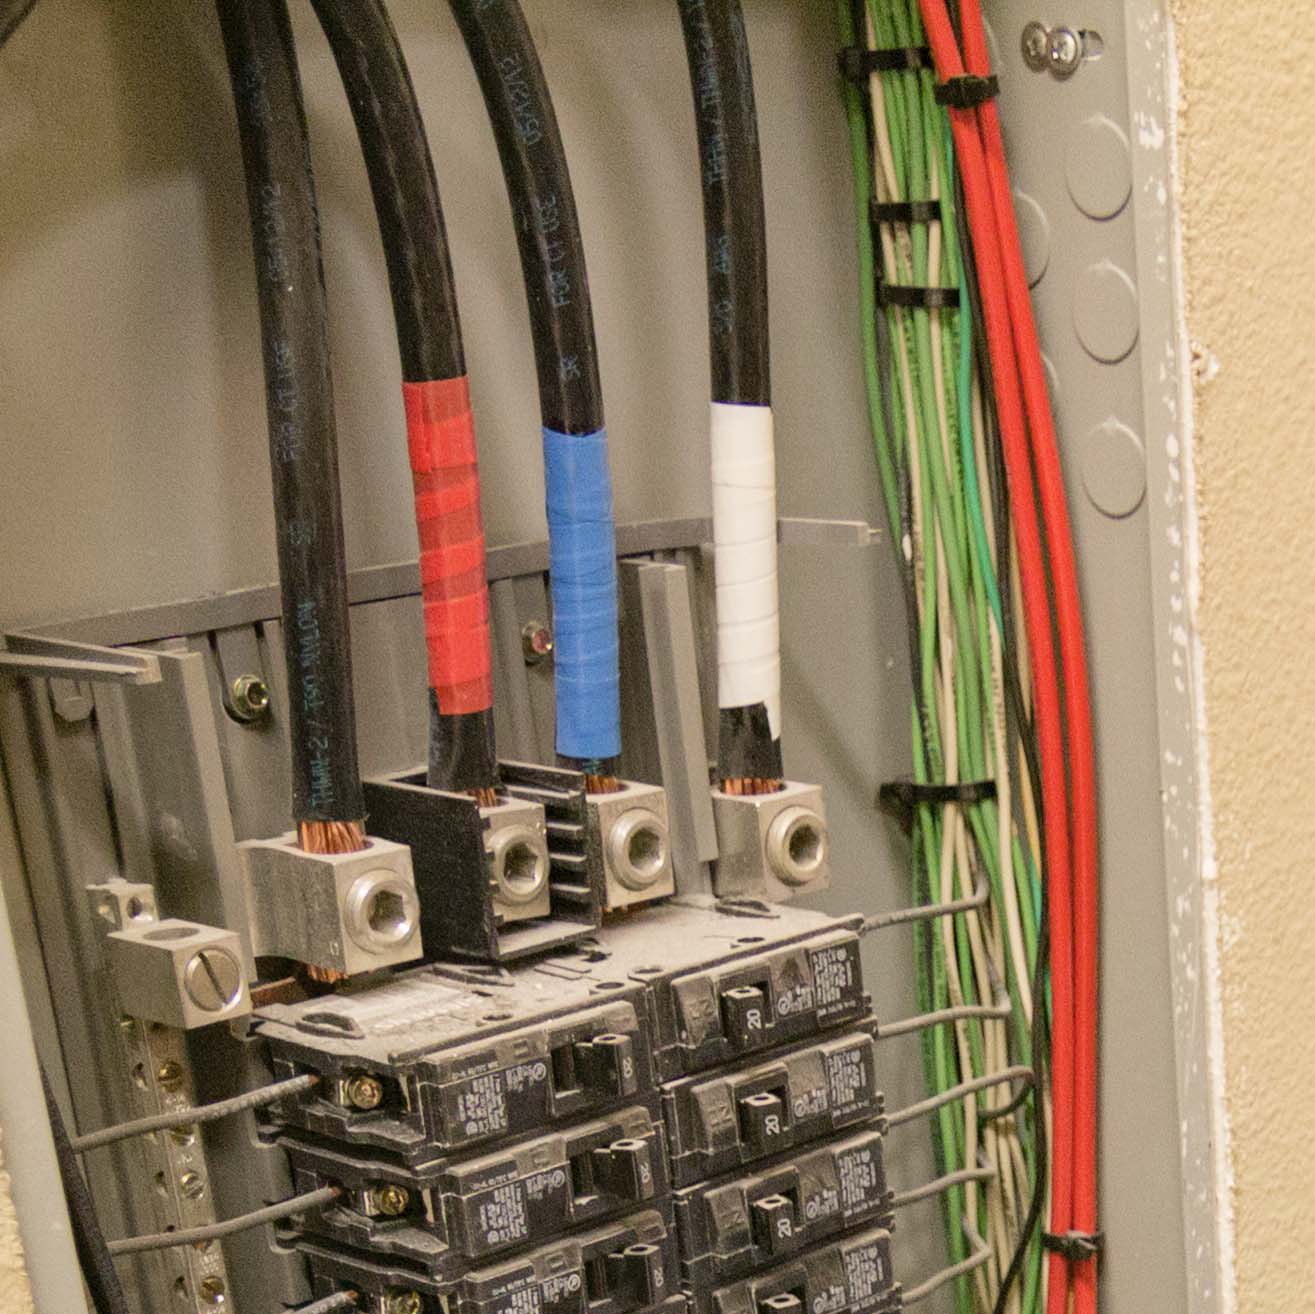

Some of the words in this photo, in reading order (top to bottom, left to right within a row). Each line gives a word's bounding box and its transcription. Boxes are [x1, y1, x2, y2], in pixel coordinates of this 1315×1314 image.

[536, 193, 561, 233] USE
[548, 270, 572, 308] FOR
[298, 601, 320, 667] NYLON
[746, 1008, 762, 1030] 20
[622, 1057, 633, 1078] 20
[765, 1115, 780, 1135] 20
[639, 1163, 650, 1183] 20
[777, 1218, 792, 1238] 20
[654, 1267, 664, 1288] 20
